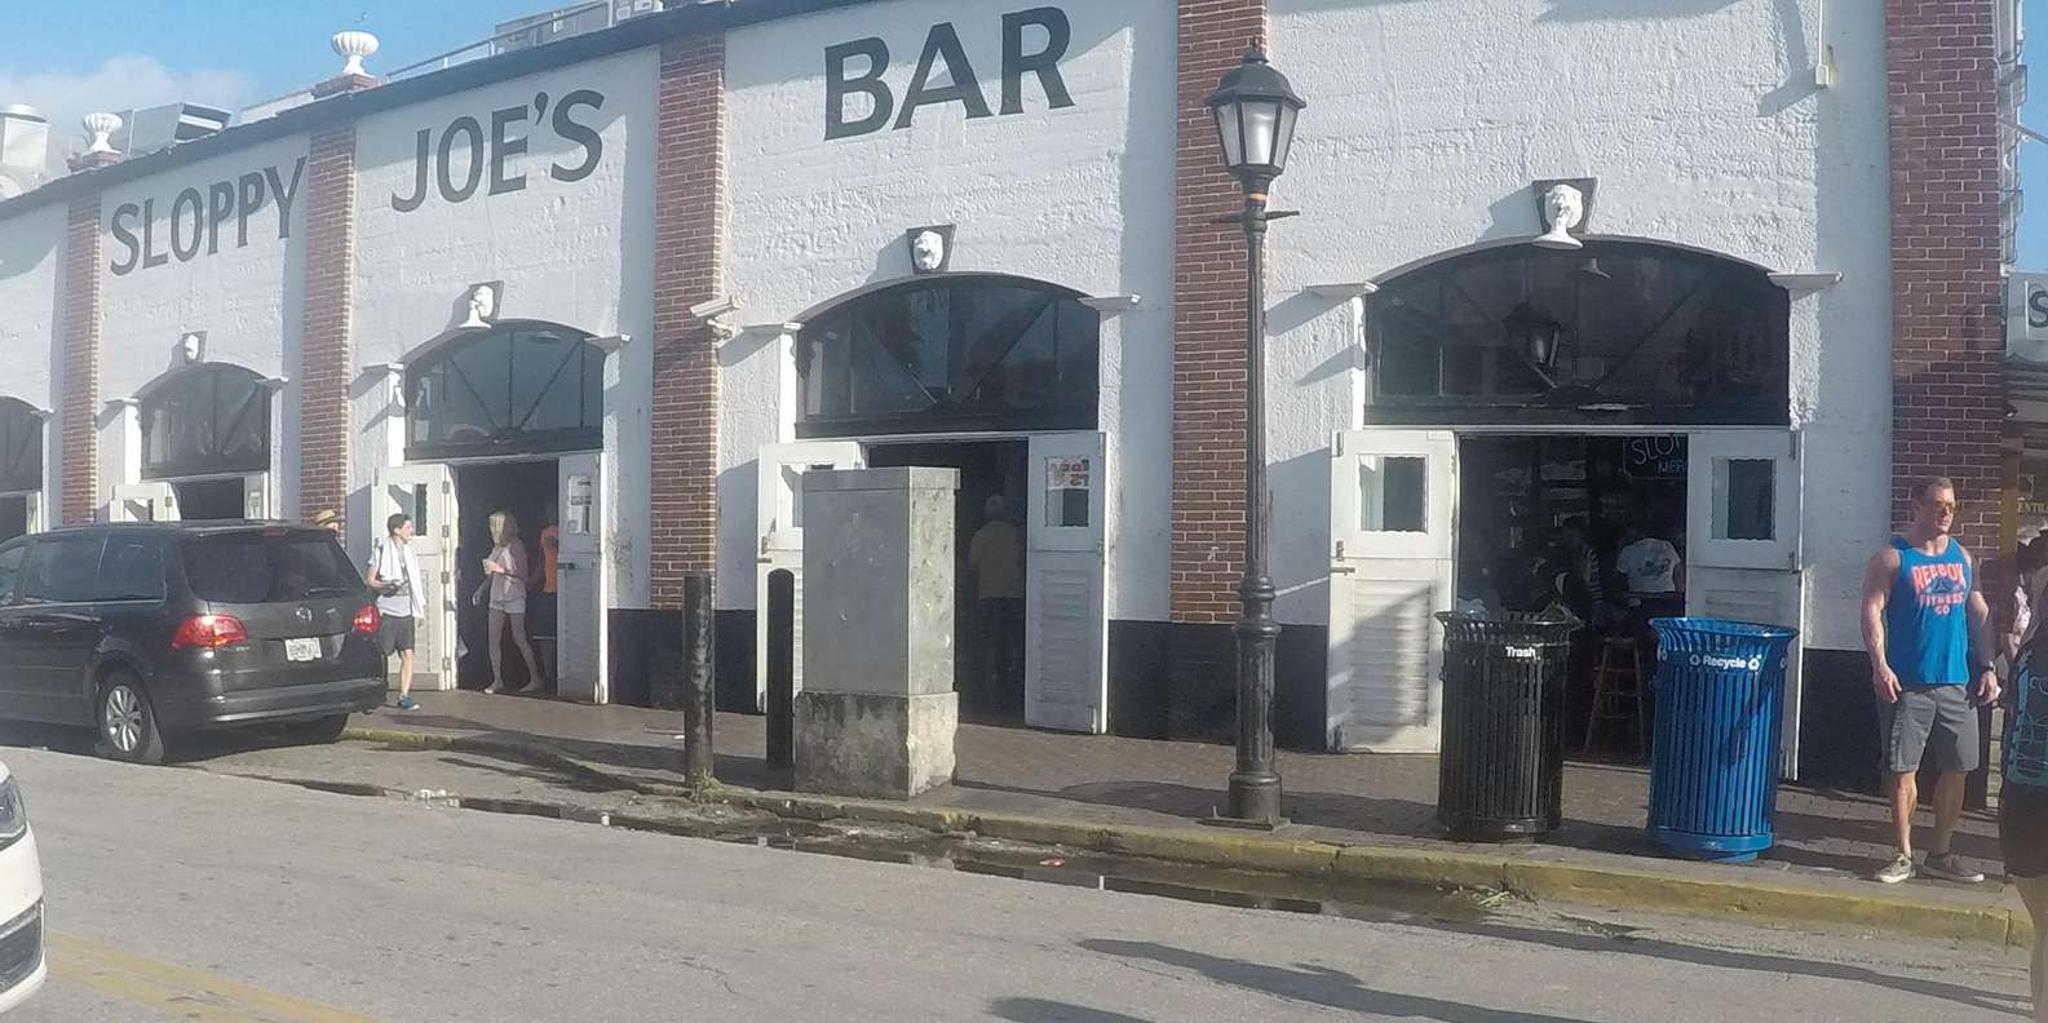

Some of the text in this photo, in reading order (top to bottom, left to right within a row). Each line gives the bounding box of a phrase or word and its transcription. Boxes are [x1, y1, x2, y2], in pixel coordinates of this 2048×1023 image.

[110, 6, 1075, 276] SLOPPY JOE'S BAR
[1911, 563, 1966, 593] REEBOK
[1934, 604, 1951, 616] CO
[1505, 646, 1536, 658] Trash
[1702, 655, 1747, 669] Recycle
